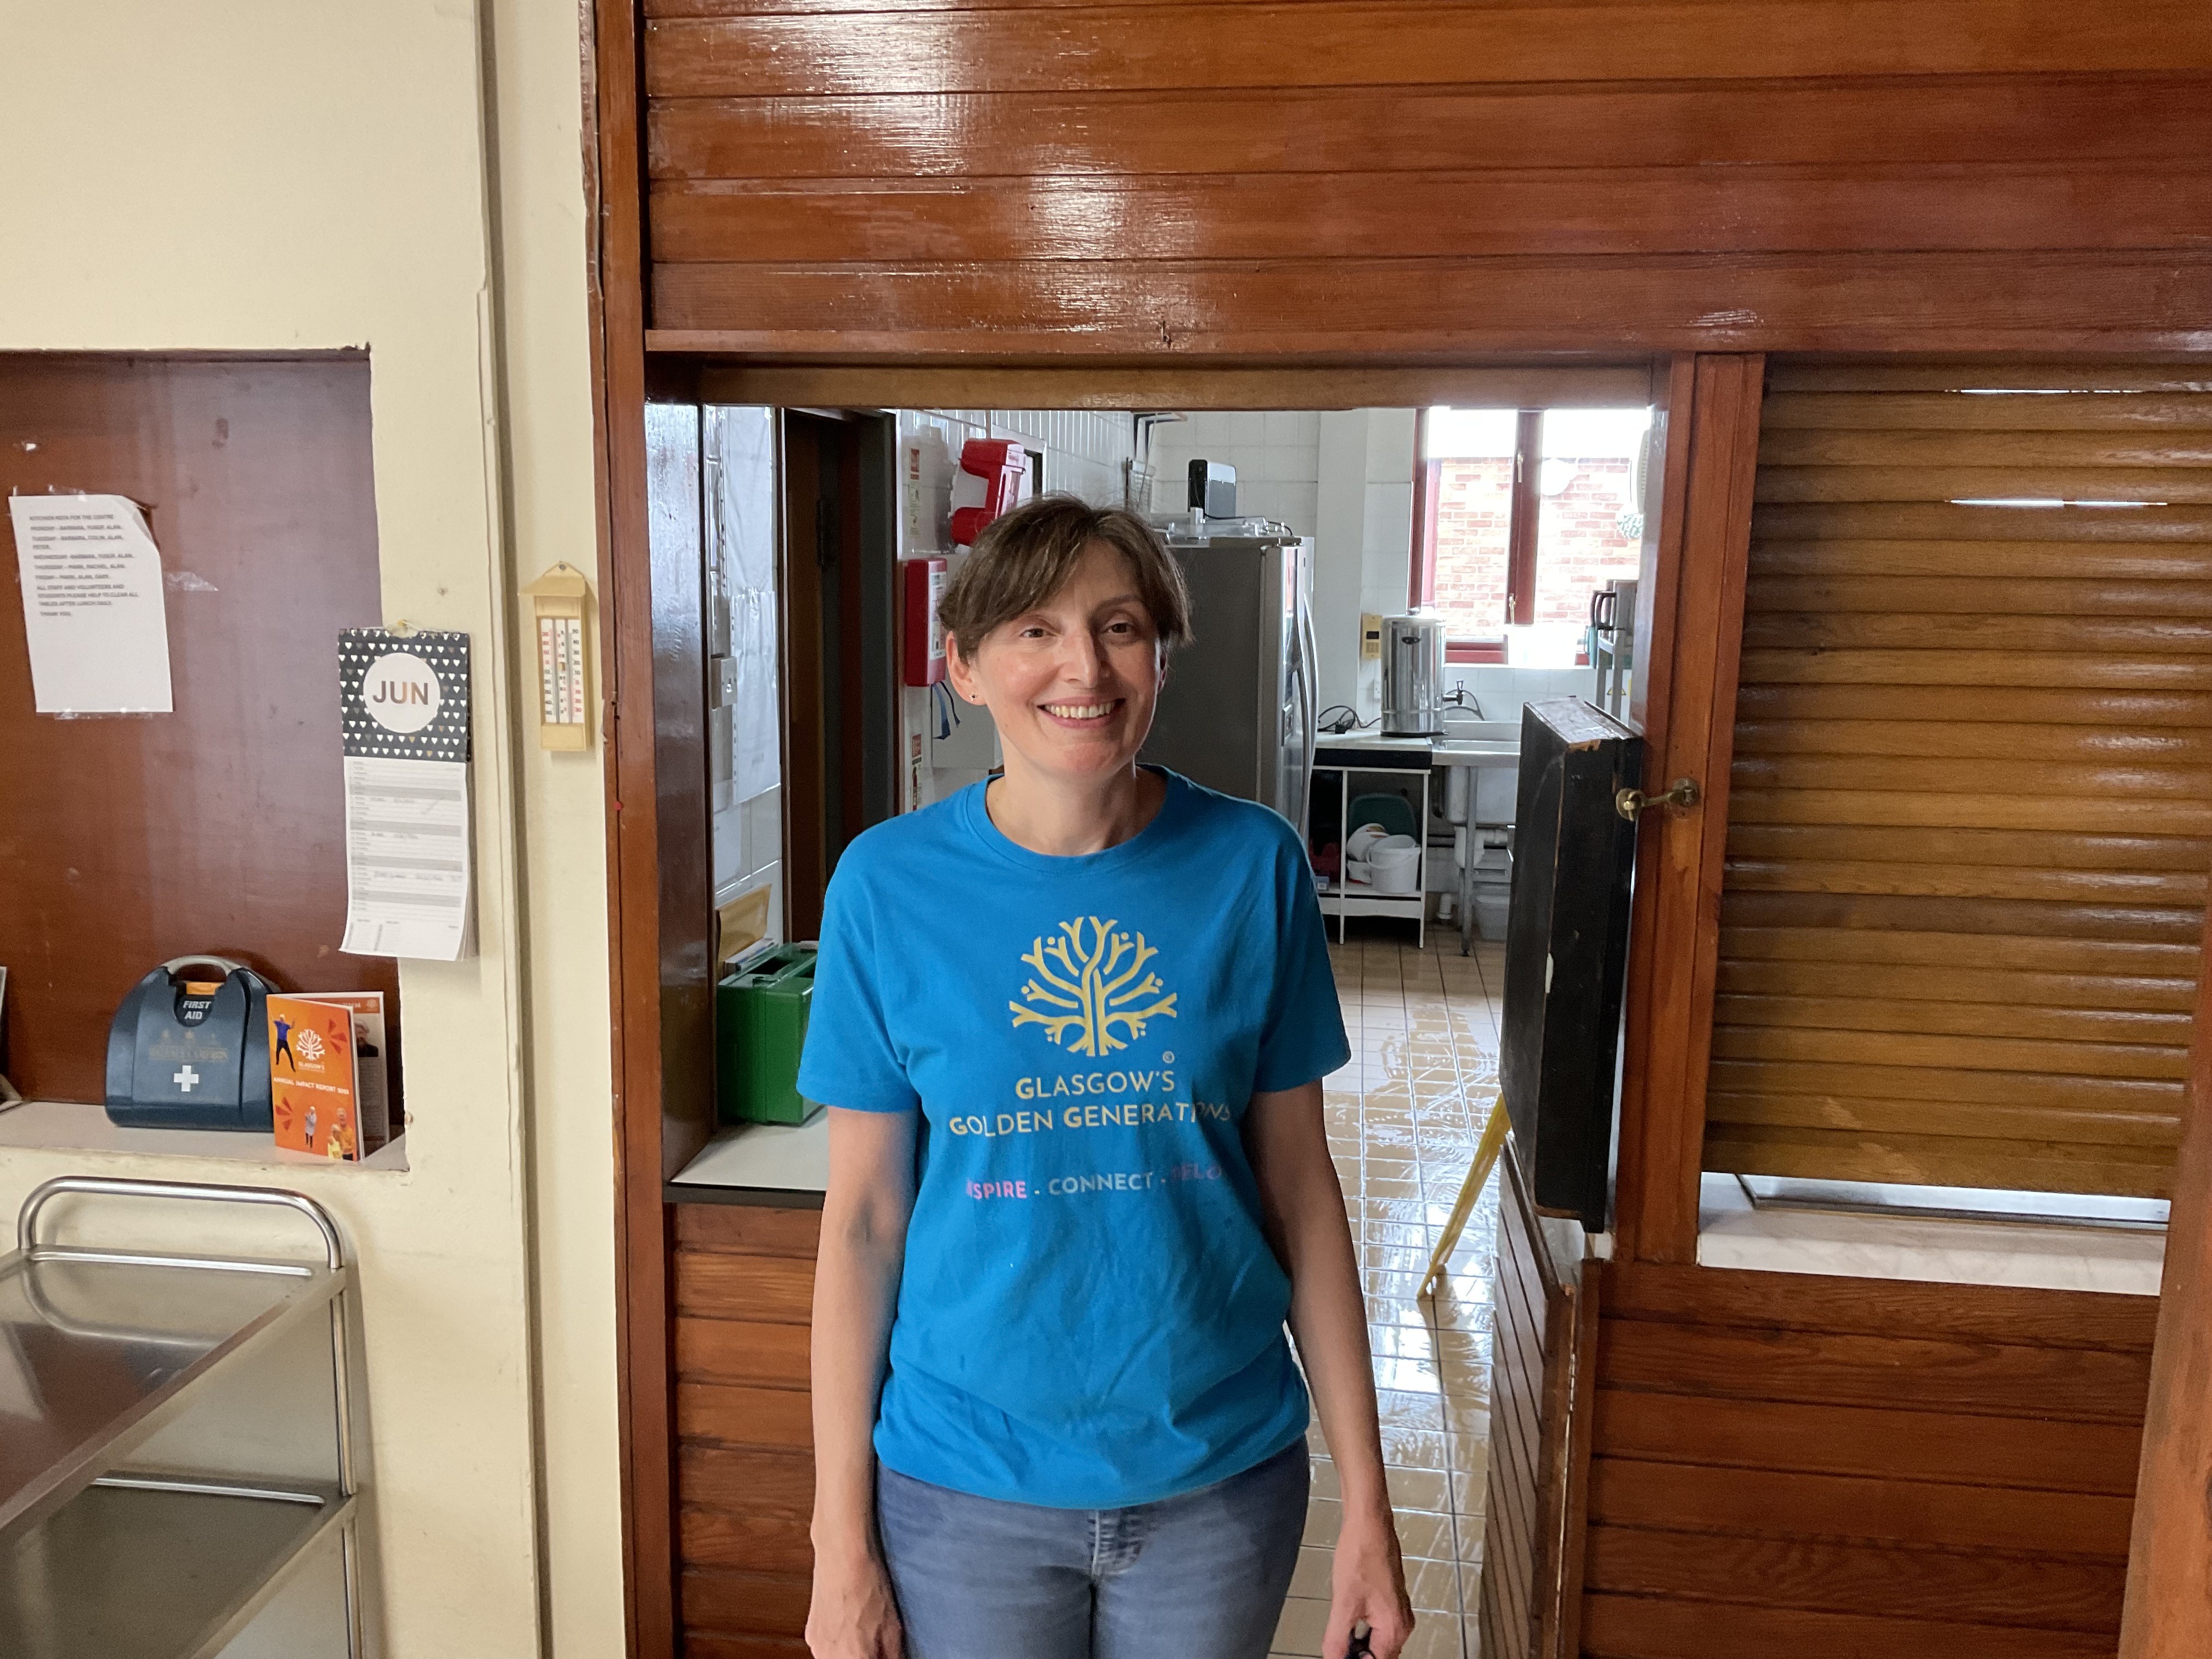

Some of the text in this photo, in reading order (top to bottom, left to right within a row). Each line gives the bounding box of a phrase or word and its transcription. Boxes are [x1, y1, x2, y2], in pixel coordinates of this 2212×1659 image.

[372, 680, 428, 705] JUN
[183, 1001, 212, 1009] FIRST
[184, 1011, 203, 1019] AID
[296, 1080, 314, 1088] IMPACT
[1015, 1071, 1175, 1099] GLASGOW'S
[949, 1110, 1053, 1137] GOLDEN
[1048, 1171, 1154, 1195] CONNECT
